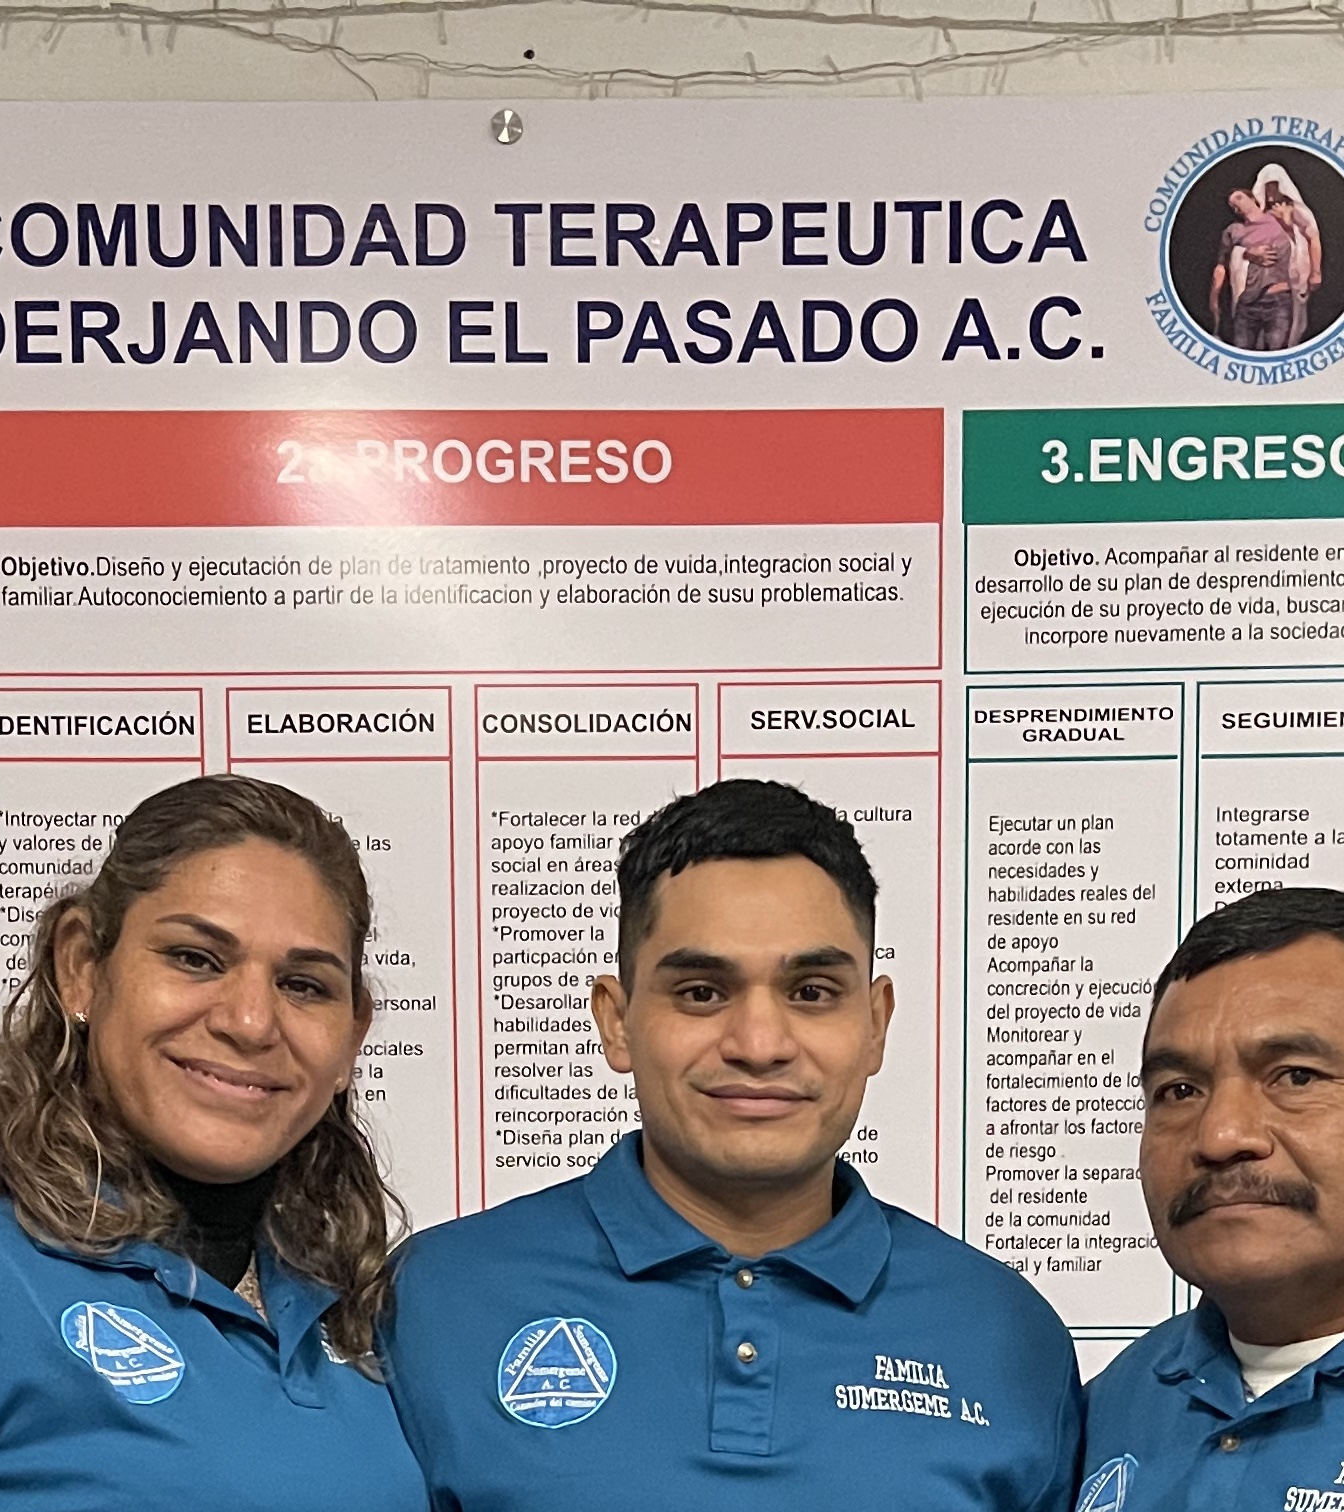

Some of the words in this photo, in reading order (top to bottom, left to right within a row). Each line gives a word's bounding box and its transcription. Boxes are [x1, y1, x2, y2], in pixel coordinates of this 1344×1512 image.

[1144, 118, 1264, 232] COMUNIDAD
[495, 199, 1087, 266] TERAPEUTICA
[449, 301, 548, 363] EL
[578, 298, 918, 364] PASADO
[942, 296, 1103, 361] A.C.
[1146, 289, 1220, 376] FAMILIA
[355, 439, 673, 484] PROGRESO
[1015, 549, 1099, 571] Objetivo.
[1105, 547, 1208, 568] Acompañar
[1214, 546, 1229, 563] al
[1236, 545, 1318, 562] residente
[275, 590, 285, 605] a
[294, 587, 343, 609] partir
[350, 586, 373, 604] de
[540, 590, 549, 609] y
[557, 584, 670, 603] elaboración
[678, 584, 701, 603] de
[708, 588, 753, 603] susu
[762, 582, 903, 607] problematicas.
[976, 575, 1063, 593] desarrollo
[1070, 574, 1091, 591] de
[1098, 578, 1117, 591] su
[1125, 574, 1161, 595] plan
[1169, 572, 1189, 589] de
[981, 601, 1064, 623] ejecución
[1072, 600, 1093, 617] de
[1100, 604, 1119, 617] su
[1127, 599, 1203, 621] proyecto
[1210, 598, 1231, 615] de
[1238, 597, 1279, 616] vida,
[1025, 628, 1108, 648] incorpore
[1115, 625, 1225, 642] nuevamente
[1232, 628, 1241, 640] a
[1249, 624, 1263, 640] la
[248, 708, 434, 733] ELABORACIÓN
[483, 709, 691, 733] CONSOLIDACIÓN
[751, 709, 915, 729] SERV.SOCIAL
[975, 707, 1173, 723] DESPRENDIMIENTO
[1023, 728, 1124, 742] GRADUAL
[990, 816, 1052, 835] Ejecutar
[1058, 819, 1075, 830] un
[1082, 815, 1113, 834] plan
[1217, 808, 1309, 825] Integrarse
[1216, 830, 1307, 845] totamente
[1315, 833, 1324, 844] a
[1216, 853, 1309, 869] cominidad
[591, 926, 604, 941] la
[988, 934, 1006, 949] de
[1012, 937, 1058, 953] apoyo
[494, 1017, 591, 1032] habilidades
[495, 1063, 563, 1077] resolver
[570, 1062, 593, 1077] las
[874, 1355, 949, 1389] FAMILIA
[835, 1384, 952, 1418] SUMERGEME
